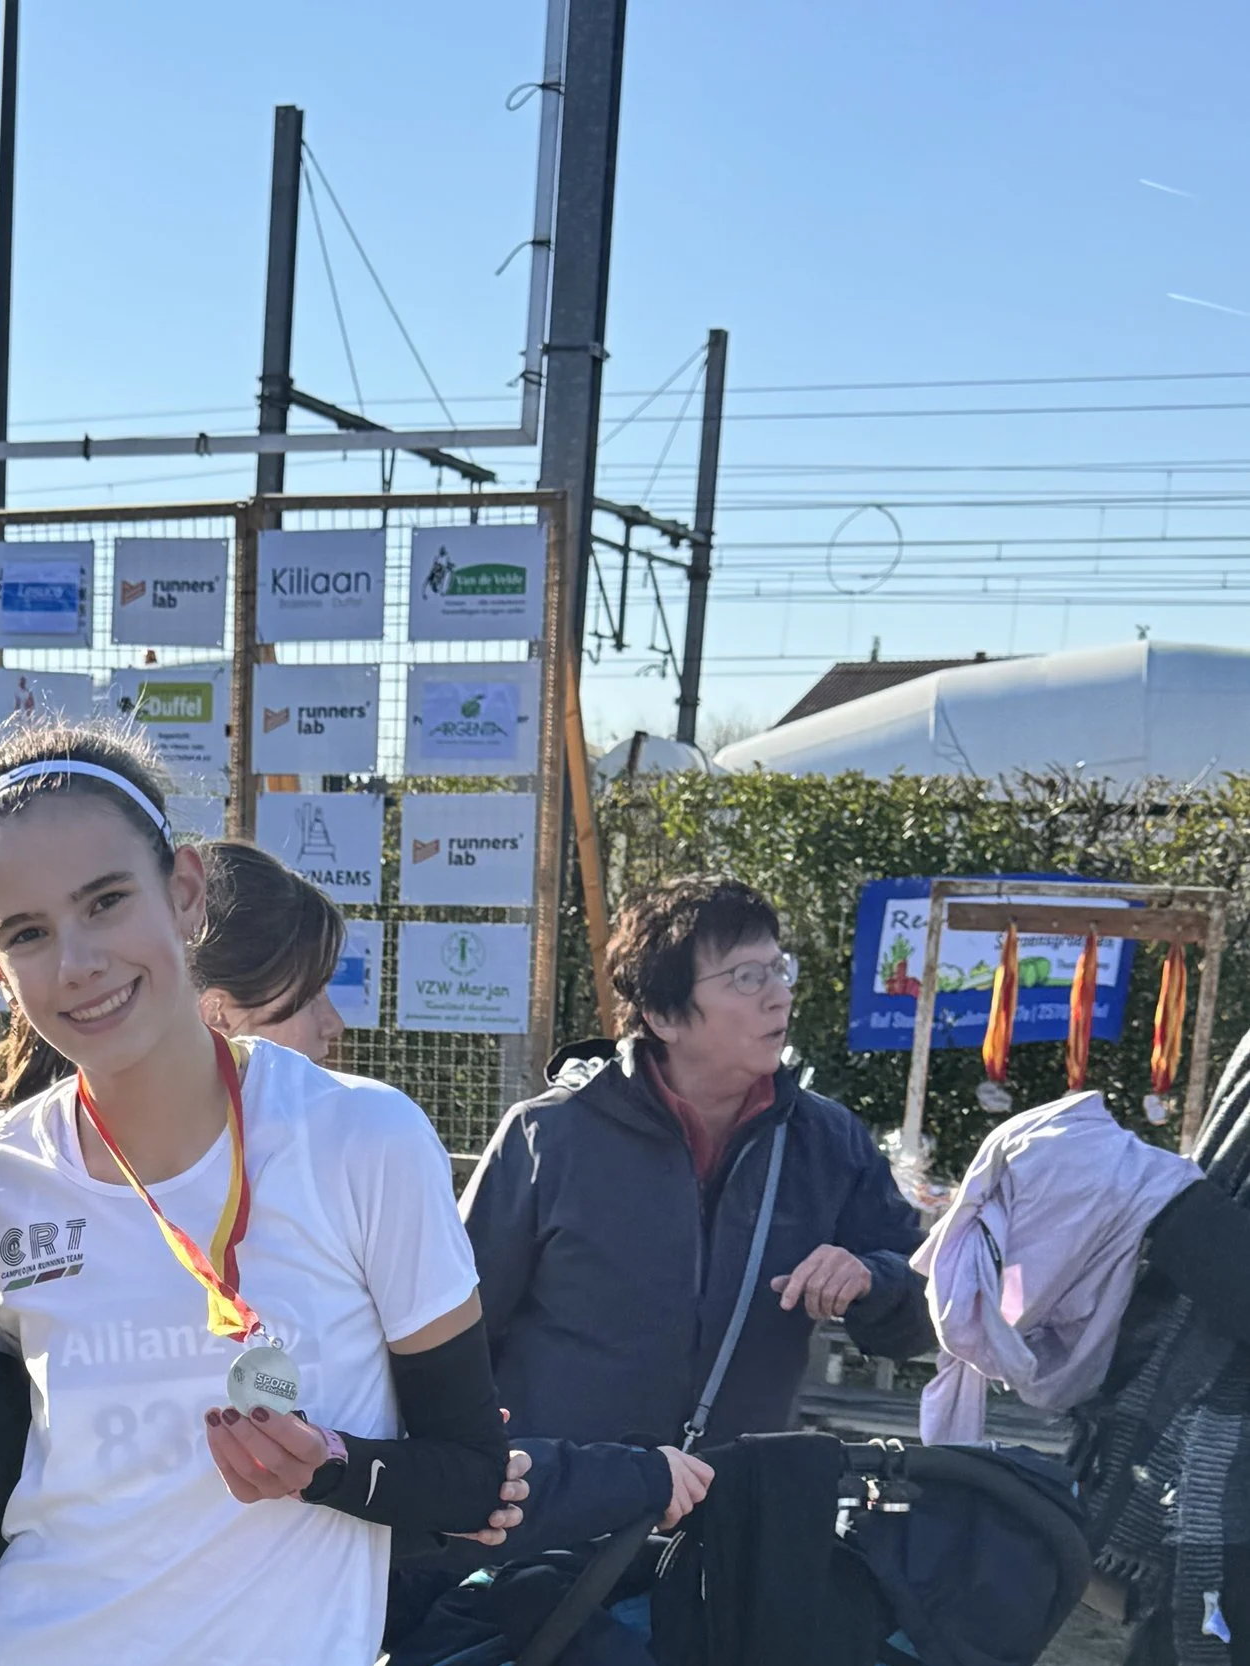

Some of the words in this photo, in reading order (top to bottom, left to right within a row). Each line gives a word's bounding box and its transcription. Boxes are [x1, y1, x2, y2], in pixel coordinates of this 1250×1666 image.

[271, 567, 371, 595] Kiliaan
[152, 593, 178, 608] lab
[149, 697, 203, 716] Duffel
[298, 720, 325, 735] lab
[448, 852, 476, 866] lab
[416, 980, 453, 996] VZW
[0, 1218, 86, 1267] CRT
[38, 1257, 65, 1270] RUNNING
[66, 1253, 84, 1264] TEAM
[61, 1319, 226, 1368] Allianz
[94, 1401, 212, 1477] 83
